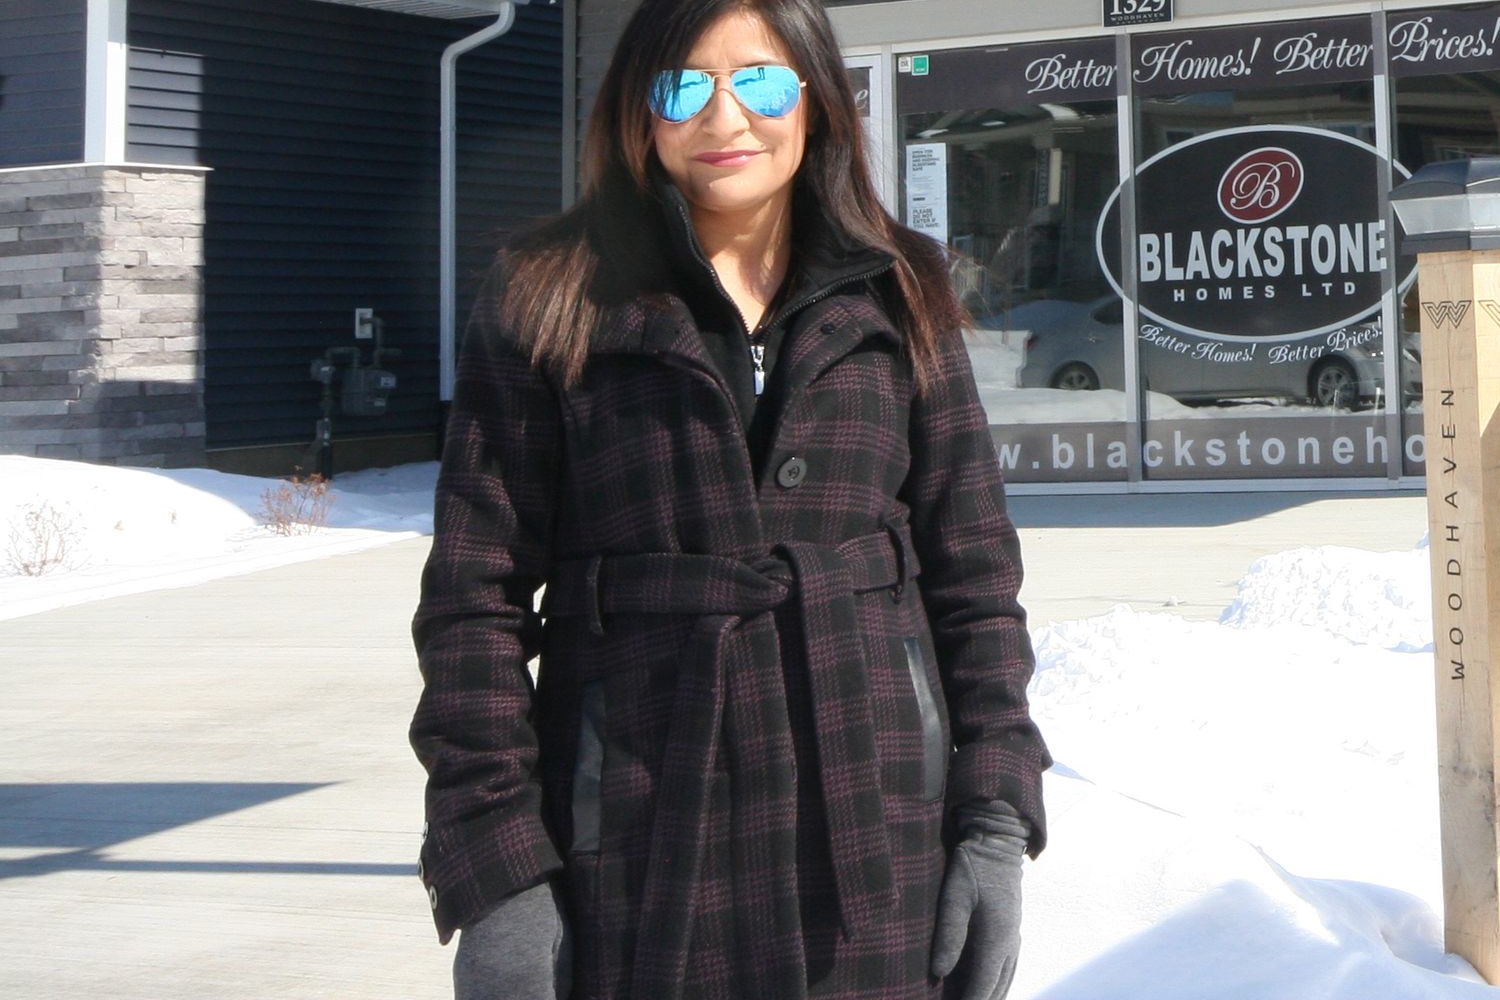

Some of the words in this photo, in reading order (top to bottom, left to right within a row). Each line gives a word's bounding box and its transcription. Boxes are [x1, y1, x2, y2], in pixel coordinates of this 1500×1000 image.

[1025, 54, 1117, 94] Better
[1133, 38, 1262, 83] Homes!
[1273, 32, 1373, 75] Better
[1139, 219, 1388, 282] BLACKSTONE
[1173, 284, 1276, 302] HOMES
[1301, 281, 1357, 298] LTD
[1138, 323, 1191, 354] Better
[1191, 342, 1256, 363] Homes!
[1268, 343, 1325, 365] Better
[1326, 315, 1383, 353] Prices!
[1440, 389, 1466, 681] WOODHAVEN
